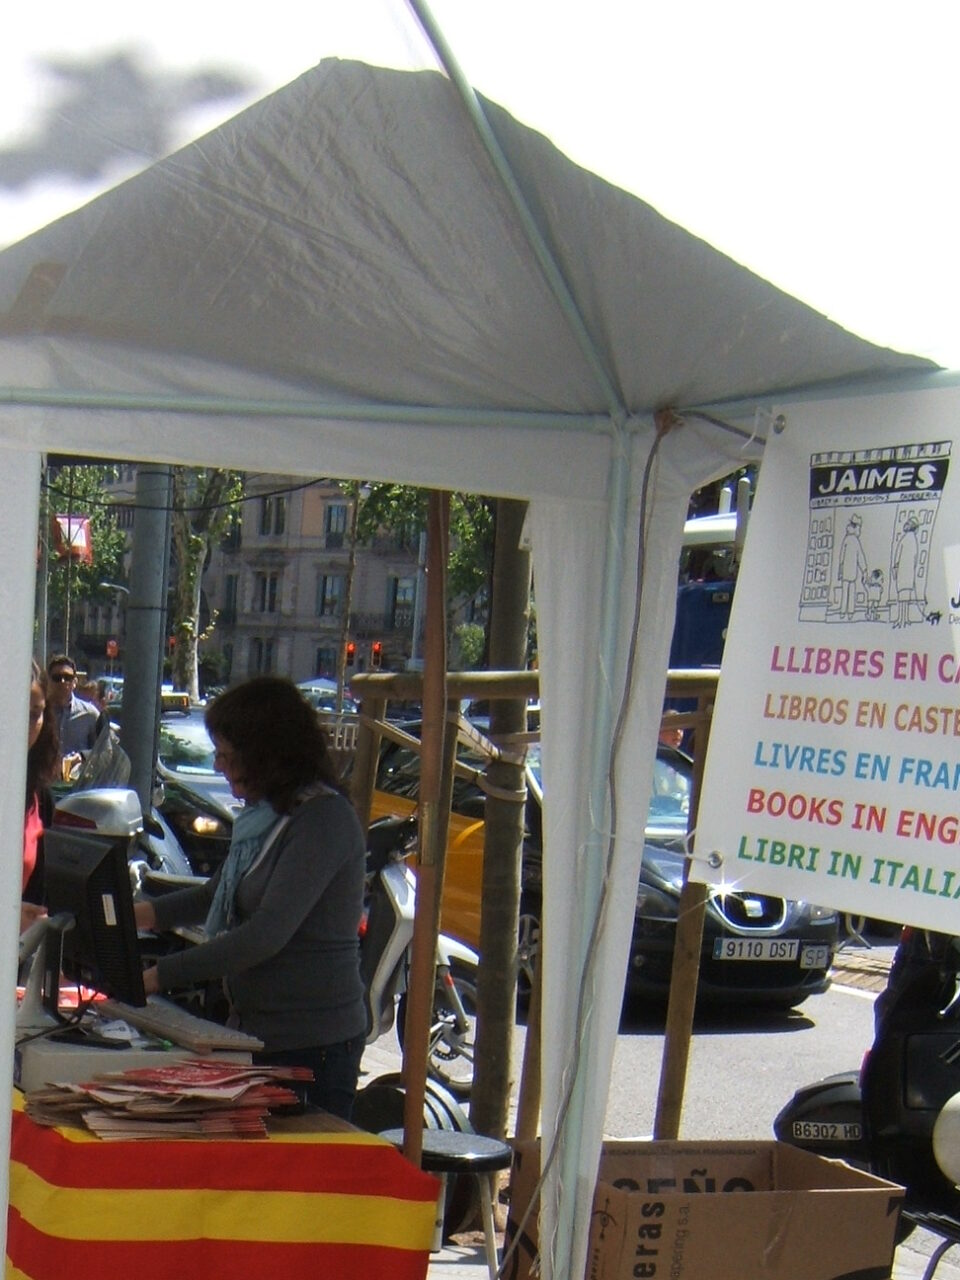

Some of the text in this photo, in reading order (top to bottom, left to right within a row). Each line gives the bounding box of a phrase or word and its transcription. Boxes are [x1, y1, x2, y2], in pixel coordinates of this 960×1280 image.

[818, 465, 937, 493] JAIMES
[771, 646, 884, 678] LLIBRES
[894, 652, 928, 681] EN
[764, 693, 848, 725] LIBROS
[856, 701, 887, 728] EN
[755, 741, 847, 776] LIVRES
[855, 753, 891, 781] EN
[747, 789, 844, 826] BOOKS
[852, 804, 887, 833] IN
[738, 836, 820, 872] LIBRI
[827, 851, 862, 879] IN
[726, 941, 796, 959] 9110 DST
[805, 951, 825, 966] SP
